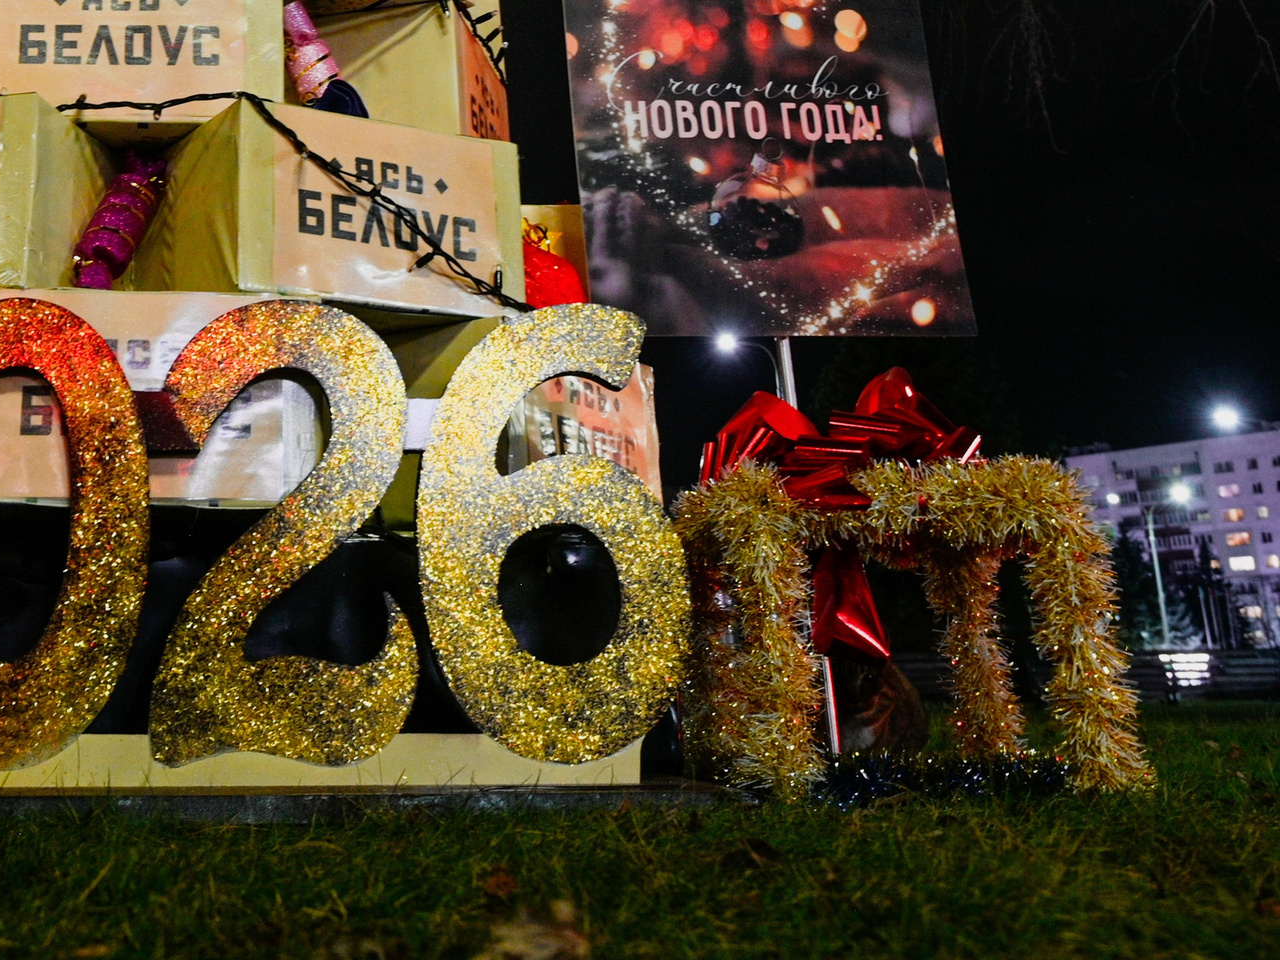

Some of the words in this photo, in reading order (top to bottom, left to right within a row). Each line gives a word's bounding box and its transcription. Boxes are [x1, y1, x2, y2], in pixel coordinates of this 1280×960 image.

[18, 24, 220, 66] БЕЛОУС
[624, 99, 768, 139] НОВОГО
[780, 101, 883, 144] ГОДА!
[354, 156, 424, 195] ЯСЬ
[298, 188, 477, 262] БЕЛОУС
